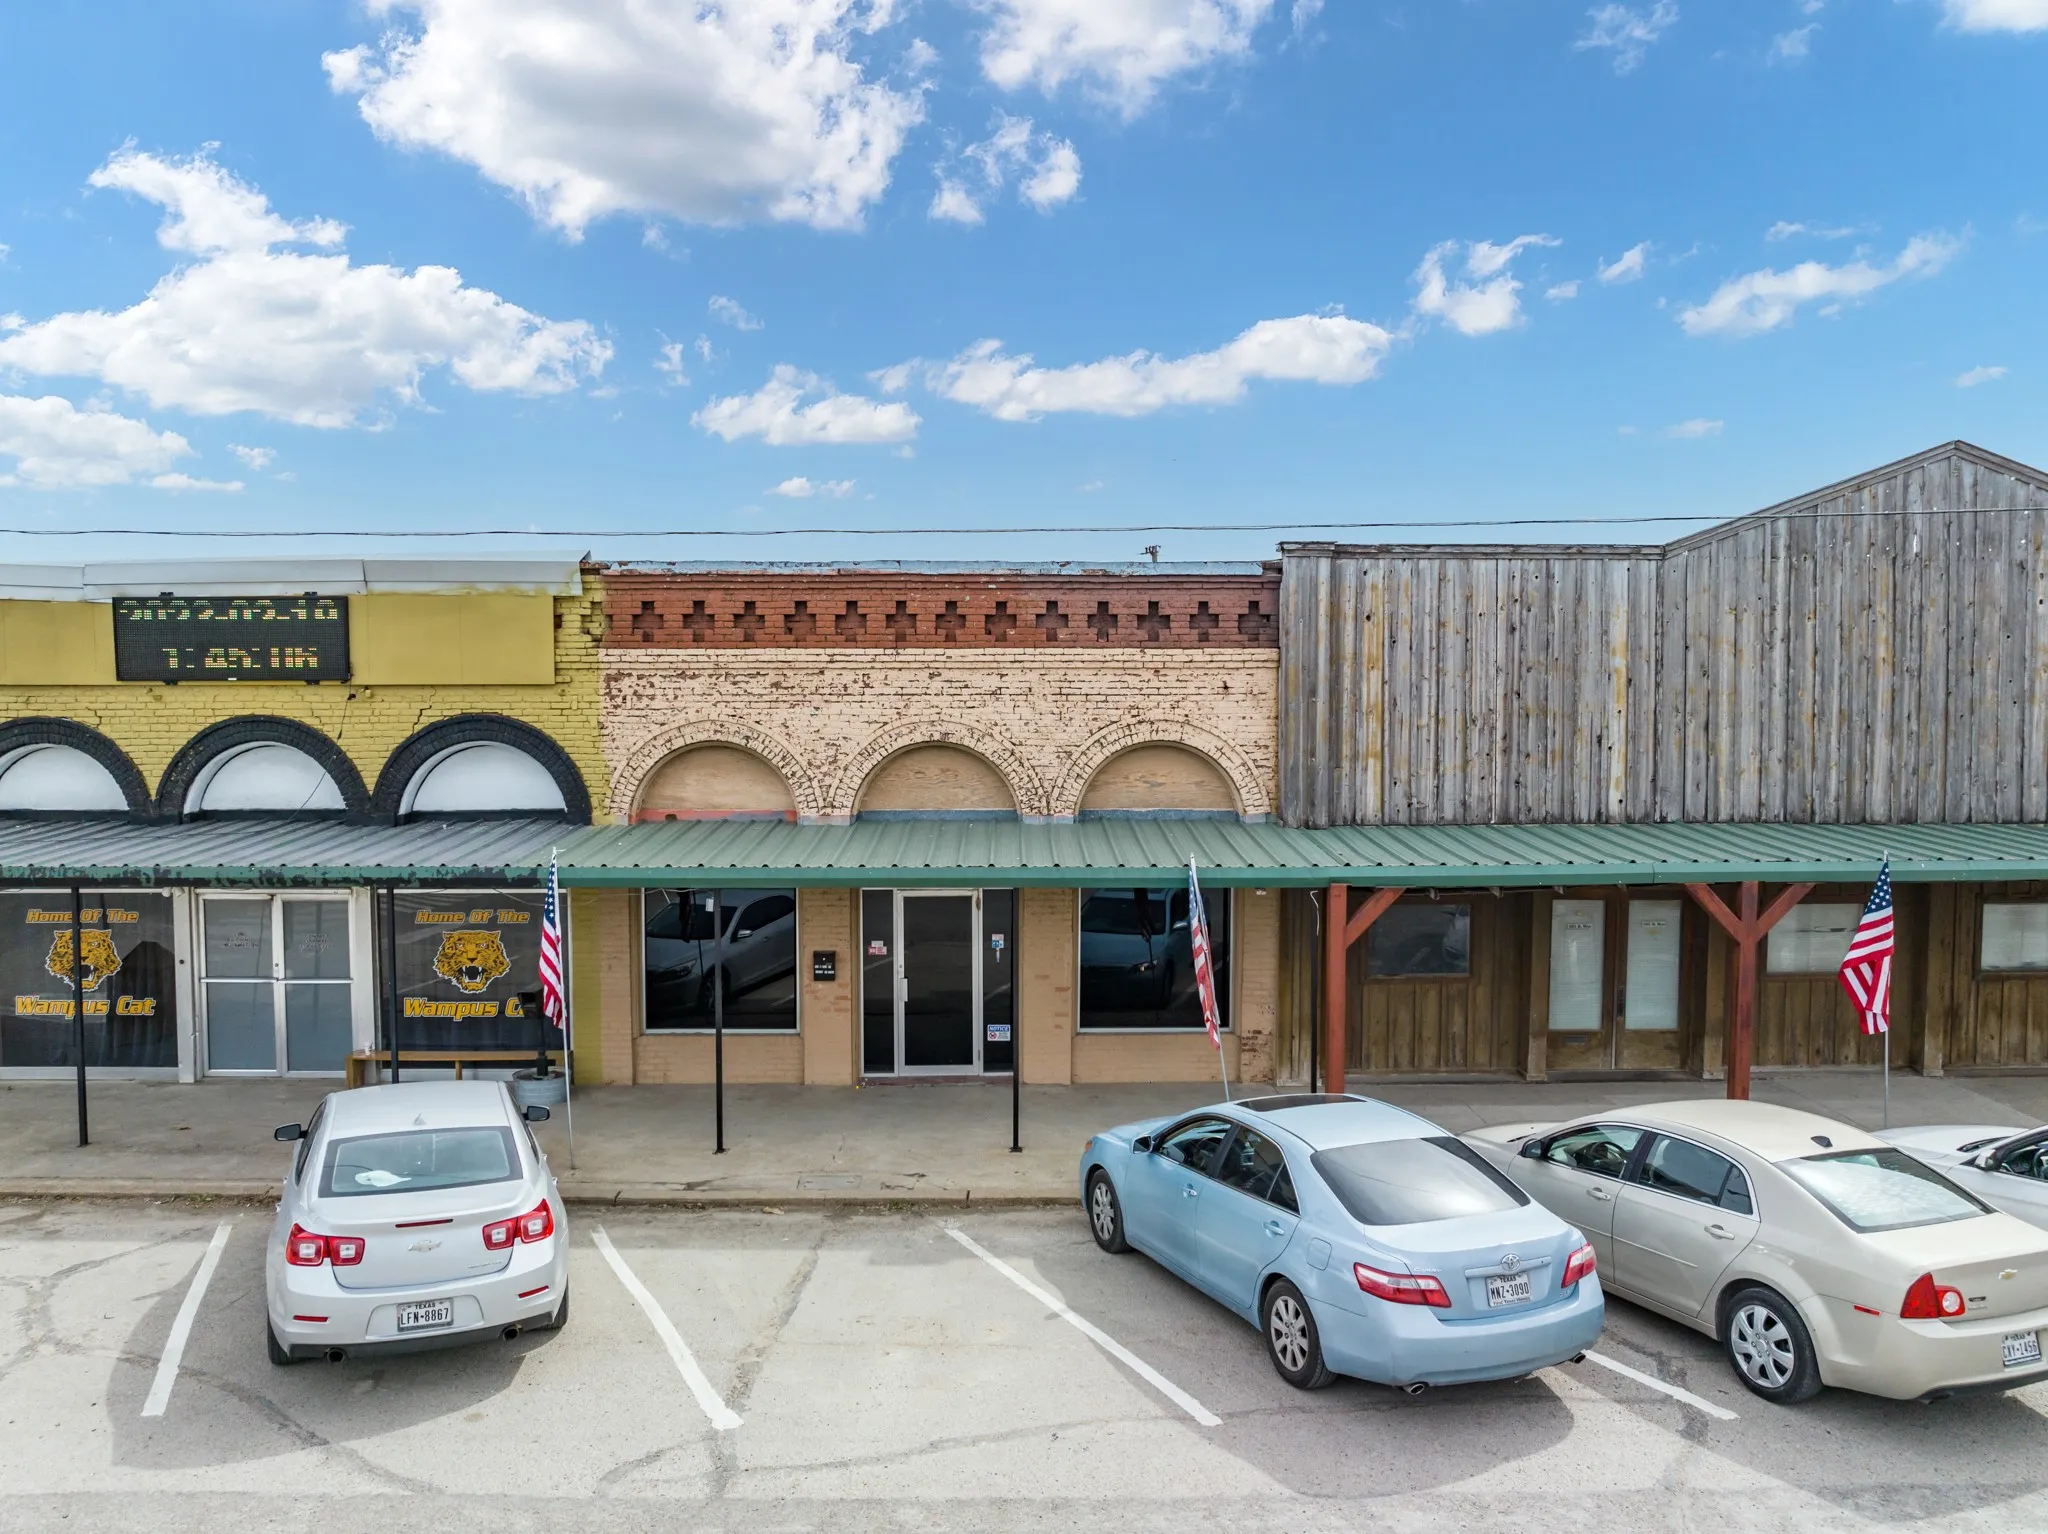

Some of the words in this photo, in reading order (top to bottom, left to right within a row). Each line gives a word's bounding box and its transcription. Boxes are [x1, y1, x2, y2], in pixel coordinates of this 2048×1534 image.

[26, 909, 73, 924] Home
[80, 909, 103, 924] Of
[107, 909, 139, 924] The
[415, 909, 465, 924] Home
[469, 909, 493, 924] Of
[497, 909, 530, 924] The
[116, 996, 156, 1015] Cat
[404, 997, 499, 1021] Wampus
[1500, 1275, 1517, 1283] TEXAS
[414, 1302, 436, 1310] TEXAS
